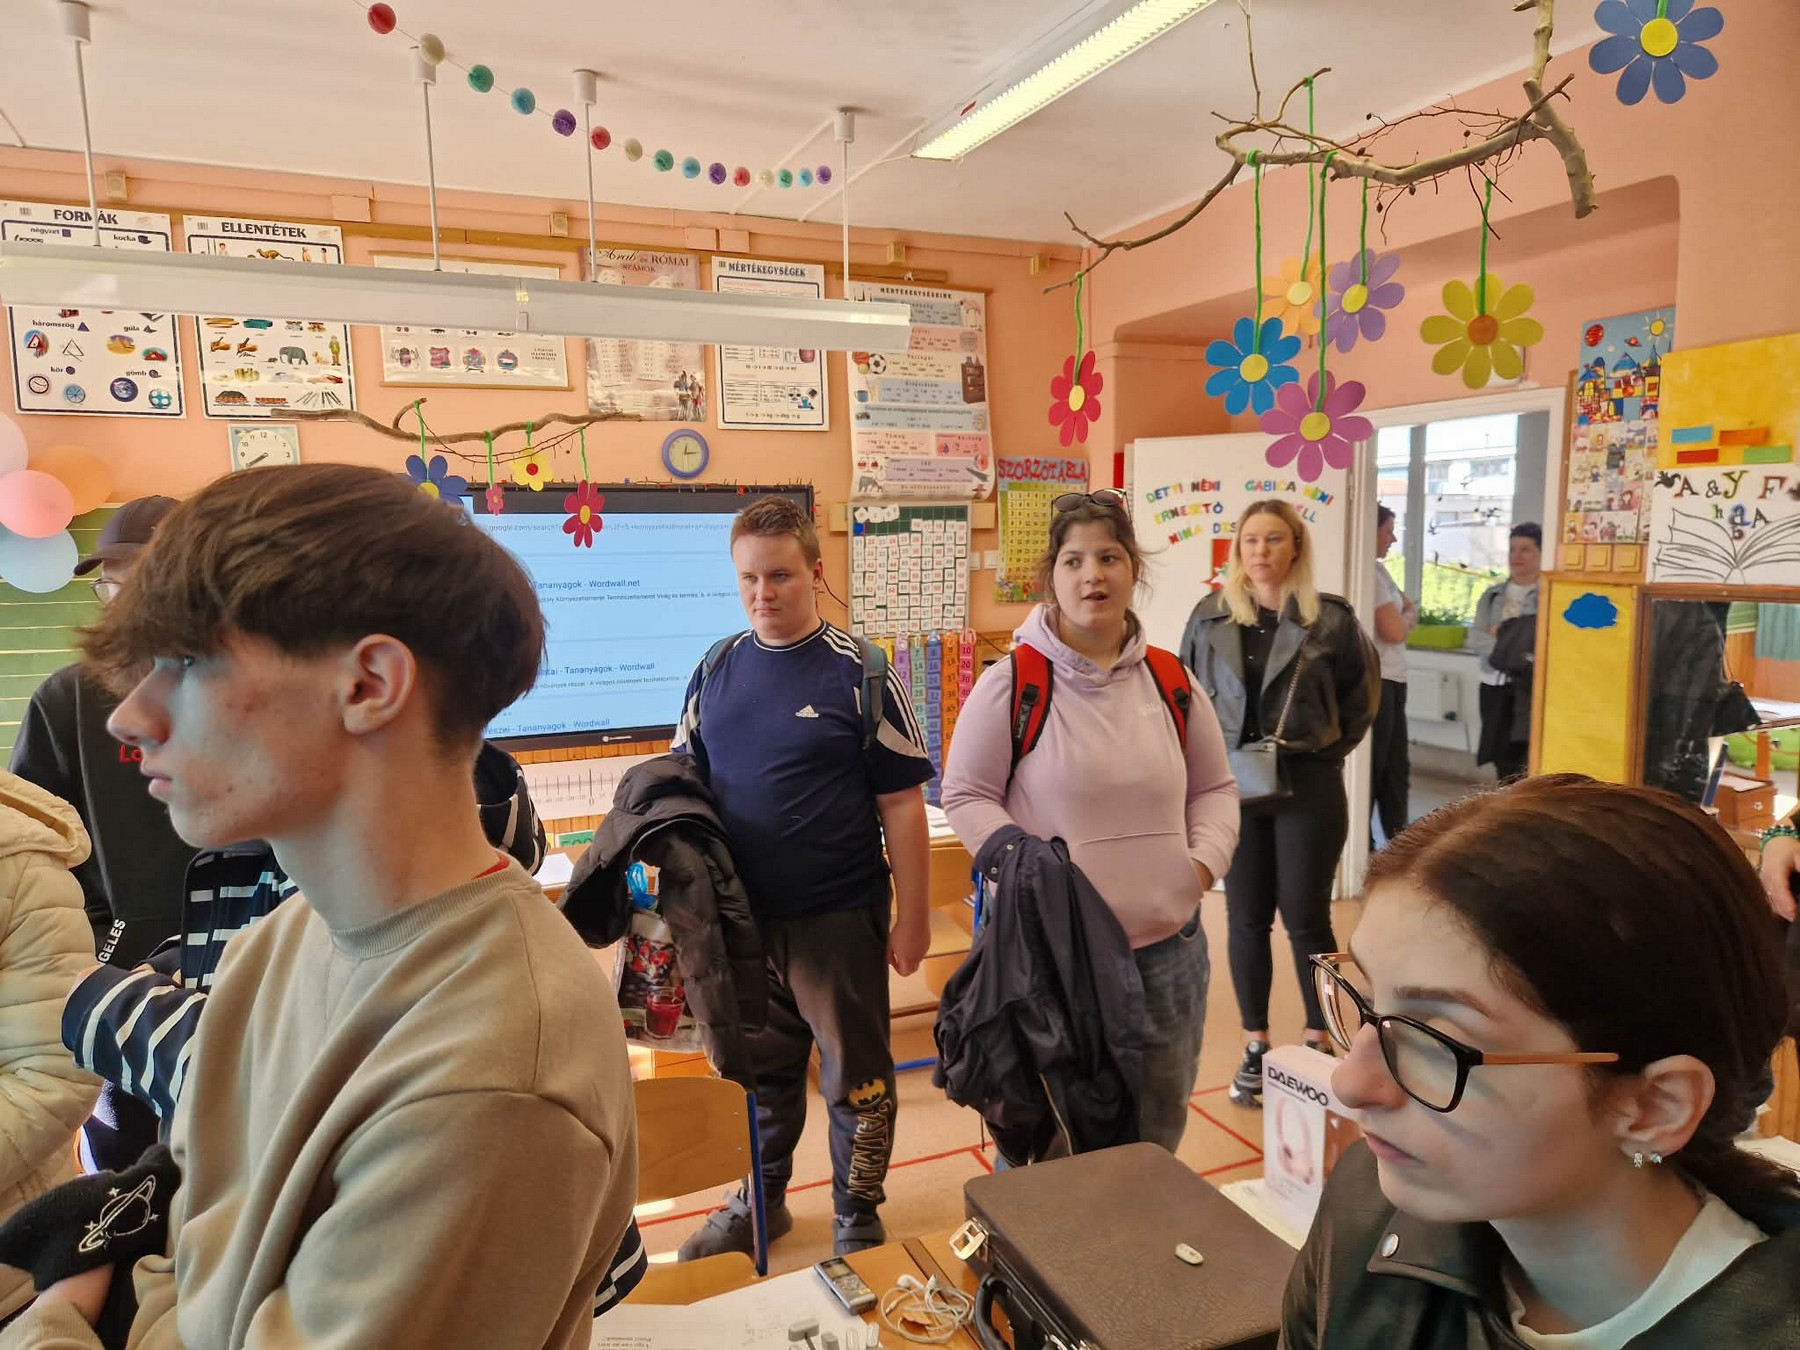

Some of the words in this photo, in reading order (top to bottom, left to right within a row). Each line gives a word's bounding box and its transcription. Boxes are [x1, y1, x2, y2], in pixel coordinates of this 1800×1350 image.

[221, 222, 307, 238] ELLENTÉTEK
[113, 234, 136, 242] kocka
[622, 263, 656, 272] SZÁMOK
[651, 254, 689, 267] RÓMAI
[728, 261, 806, 277] MÉRTÉKEGYSÉGEK
[32, 319, 75, 329] háromszög
[1146, 482, 1183, 503] DETTI
[1191, 477, 1221, 493] NÉNI
[1674, 475, 1700, 498] A
[1758, 476, 1788, 500] F
[534, 581, 582, 590] Tananyagok
[589, 579, 640, 588] Wordwall.net
[565, 665, 613, 676] Tananyagok
[619, 662, 655, 671] Wordwall
[518, 723, 566, 733] Tananyagok
[573, 719, 610, 728] Wordwall
[119, 745, 143, 763] Lo
[98, 918, 127, 965] GELES
[1268, 1065, 1329, 1106] DAEWOO
